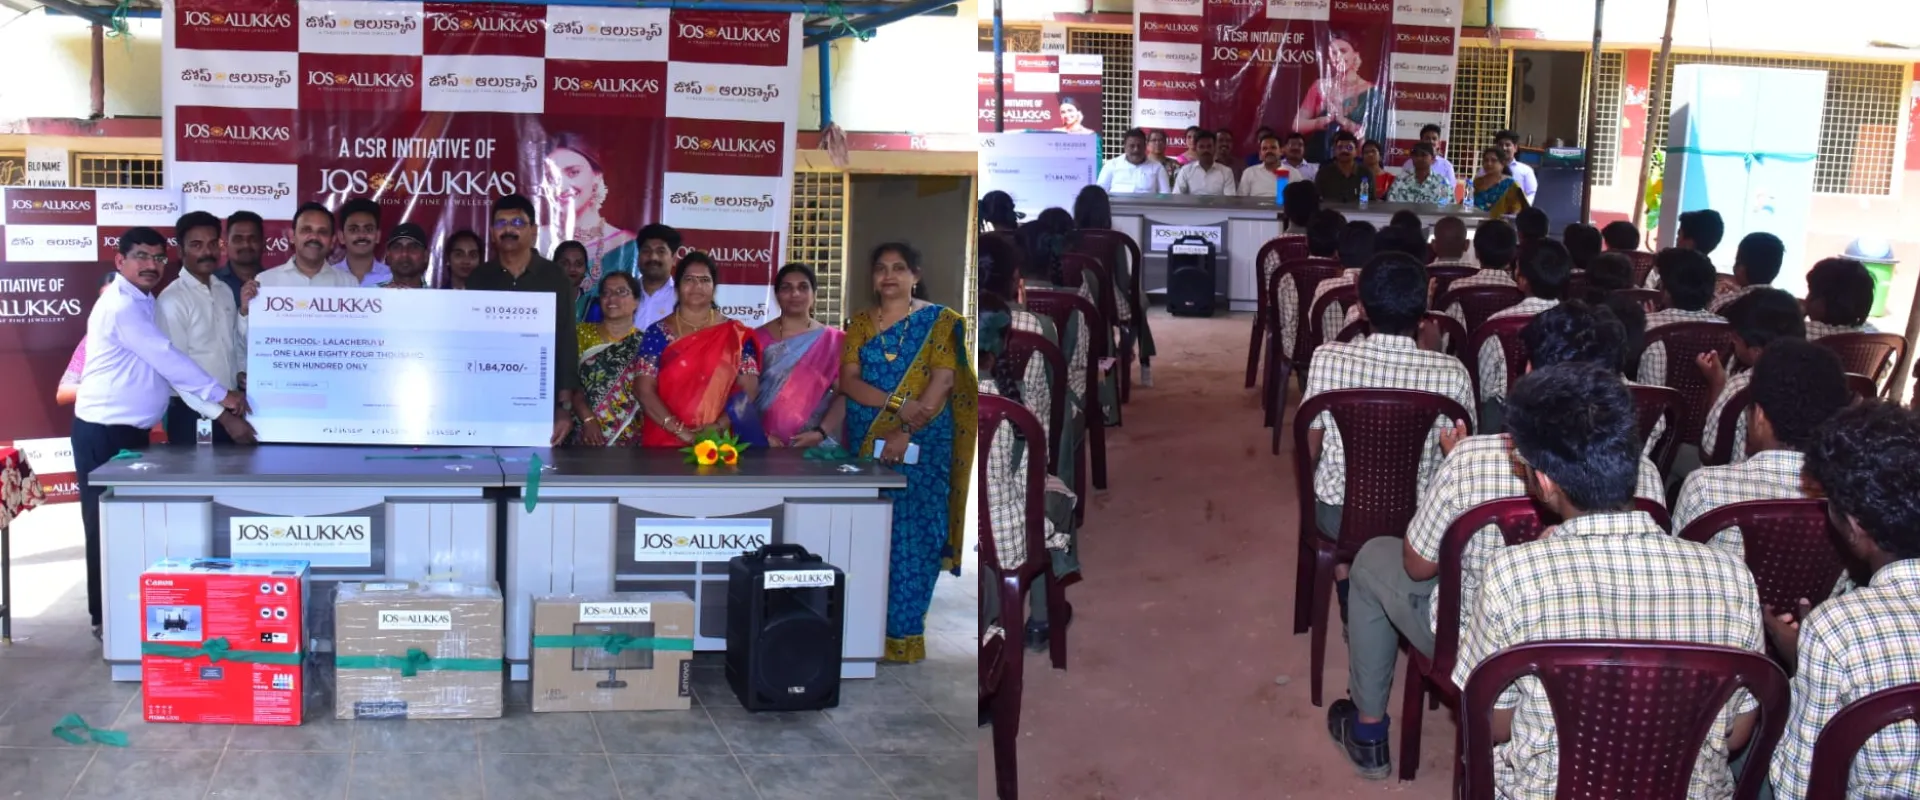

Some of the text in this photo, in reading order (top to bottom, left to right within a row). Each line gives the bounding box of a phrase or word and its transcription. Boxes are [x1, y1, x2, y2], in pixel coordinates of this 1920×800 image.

[183, 11, 292, 28] JOS ALUKKAS
[431, 16, 538, 34] JOS ALUKKAS
[677, 23, 781, 43] JOS ALUKKAS
[1231, 31, 1248, 43] CSR
[1293, 33, 1305, 44] OF
[1211, 46, 1239, 61] JOS
[1250, 47, 1315, 64] ALUKKAS
[307, 71, 414, 88] JOS ALUKKAS
[552, 76, 659, 94] JOS ALUKKAS
[183, 123, 290, 141] JOS ALUKKAS
[338, 137, 496, 159] A CSR INITIATIVE OF
[674, 135, 776, 154] JOS ALUKKAS
[41, 161, 61, 172] NAME
[317, 168, 516, 197] JOS ALUKKAS
[12, 200, 91, 211] JOS ALUKKAS
[103, 236, 121, 247] JOS
[708, 247, 771, 263] ALUKKAS
[49, 278, 65, 292] OF
[0, 299, 82, 316] LUKKAS
[263, 296, 383, 314] JOS ALUKKAS
[264, 337, 281, 345] ZPH
[273, 350, 291, 358] ONE
[293, 350, 316, 358] LAKH
[318, 350, 348, 358] EIGHTY
[350, 351, 374, 359] FOUR
[302, 362, 343, 370] HUNDRED
[346, 362, 368, 371] ONLY
[237, 524, 365, 541] JOS ALUKKAS
[642, 533, 765, 550] JOS ALUKKAS
[145, 579, 174, 587] Canon
[382, 613, 450, 624] JOS ALUKKAS
[583, 606, 649, 616] JOS ALUKKAS
[681, 661, 690, 696] Lenovo
